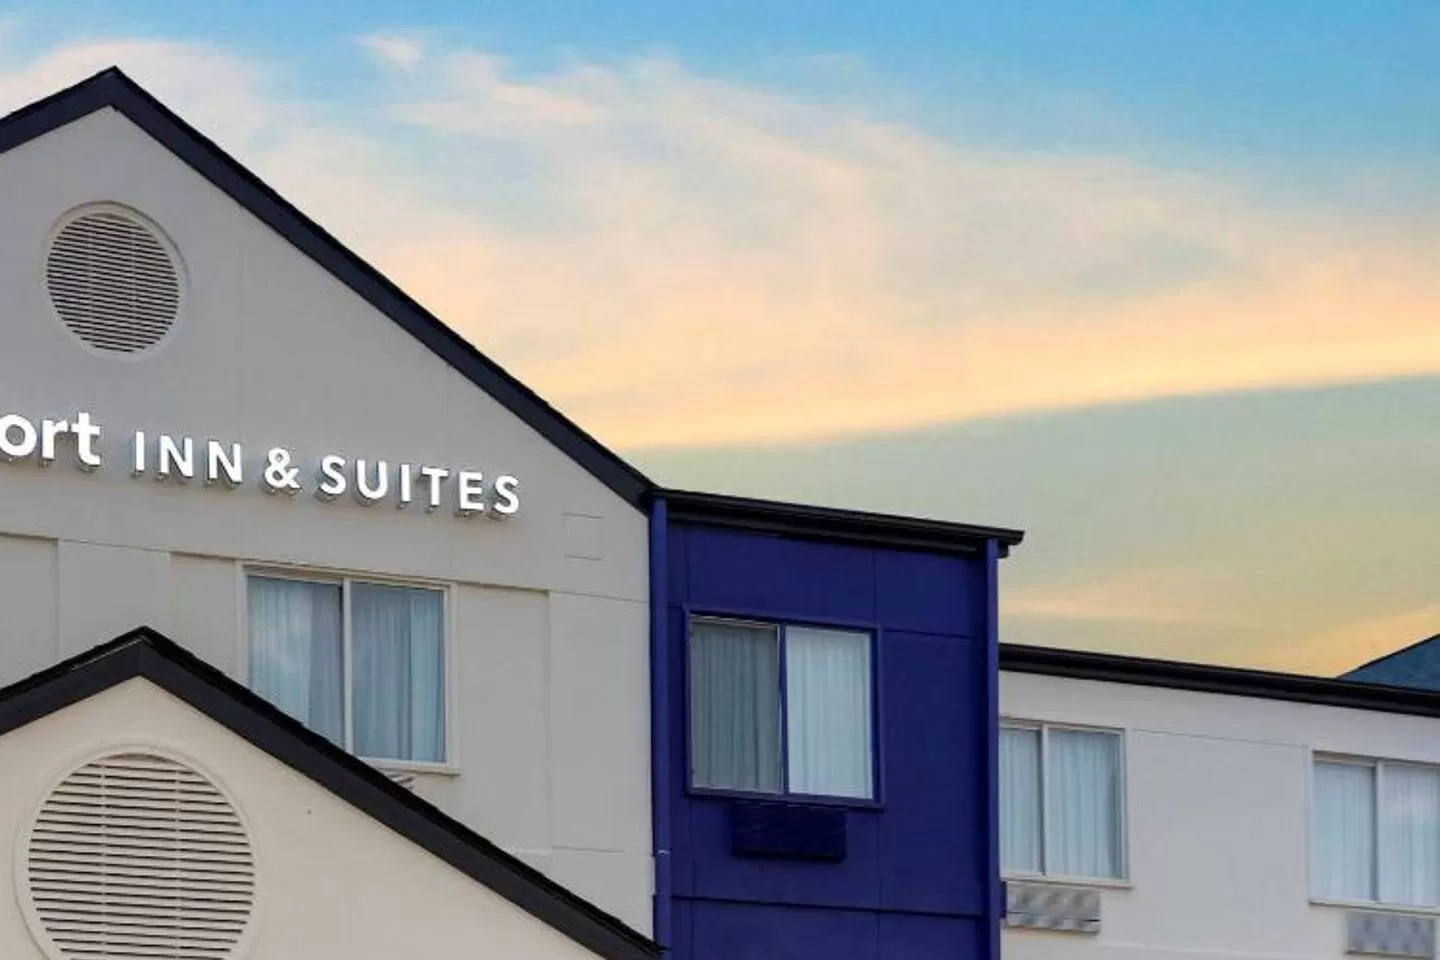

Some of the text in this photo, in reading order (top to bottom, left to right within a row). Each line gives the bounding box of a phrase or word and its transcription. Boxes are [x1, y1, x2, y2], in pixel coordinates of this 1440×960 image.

[134, 430, 243, 483] INN
[263, 446, 301, 491] &
[319, 454, 521, 514] SUITES
